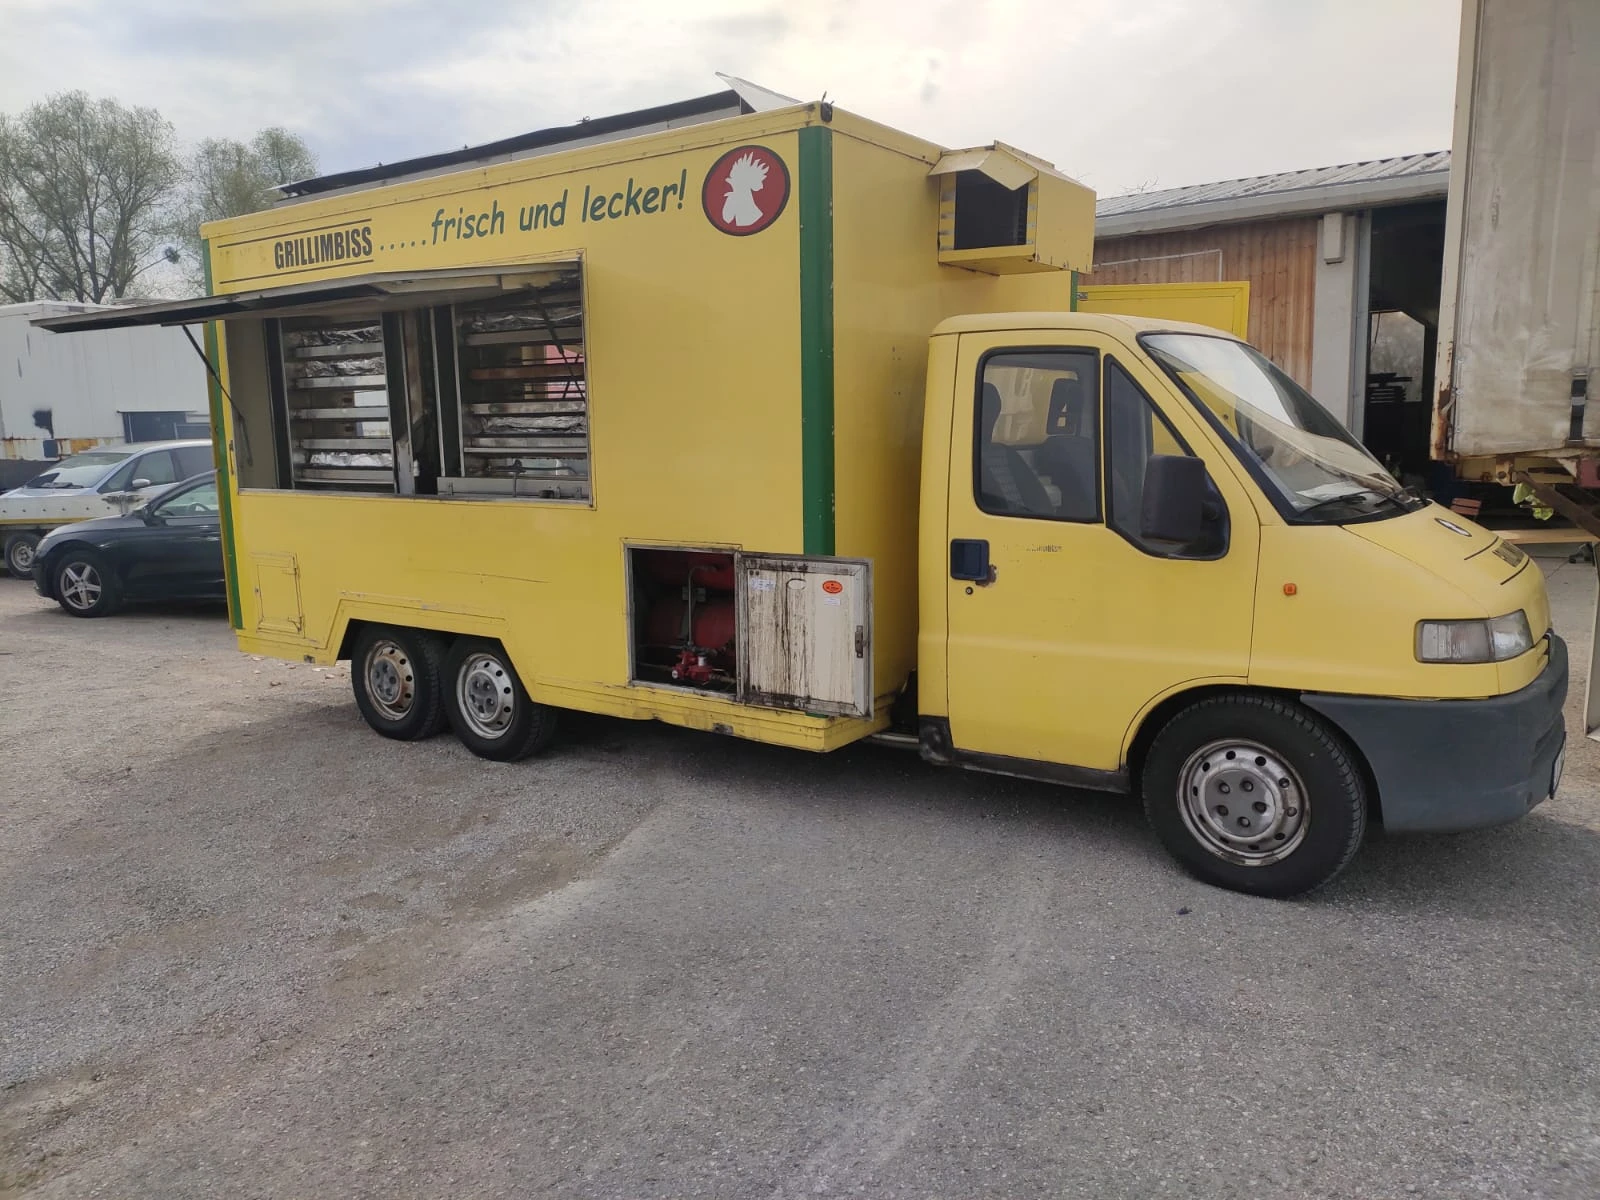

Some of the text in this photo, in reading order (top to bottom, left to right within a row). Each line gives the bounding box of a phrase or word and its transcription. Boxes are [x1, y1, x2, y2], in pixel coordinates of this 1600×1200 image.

[274, 226, 373, 270] GRILLIMBISS
[519, 189, 569, 232] und
[581, 168, 687, 223] lecker!
